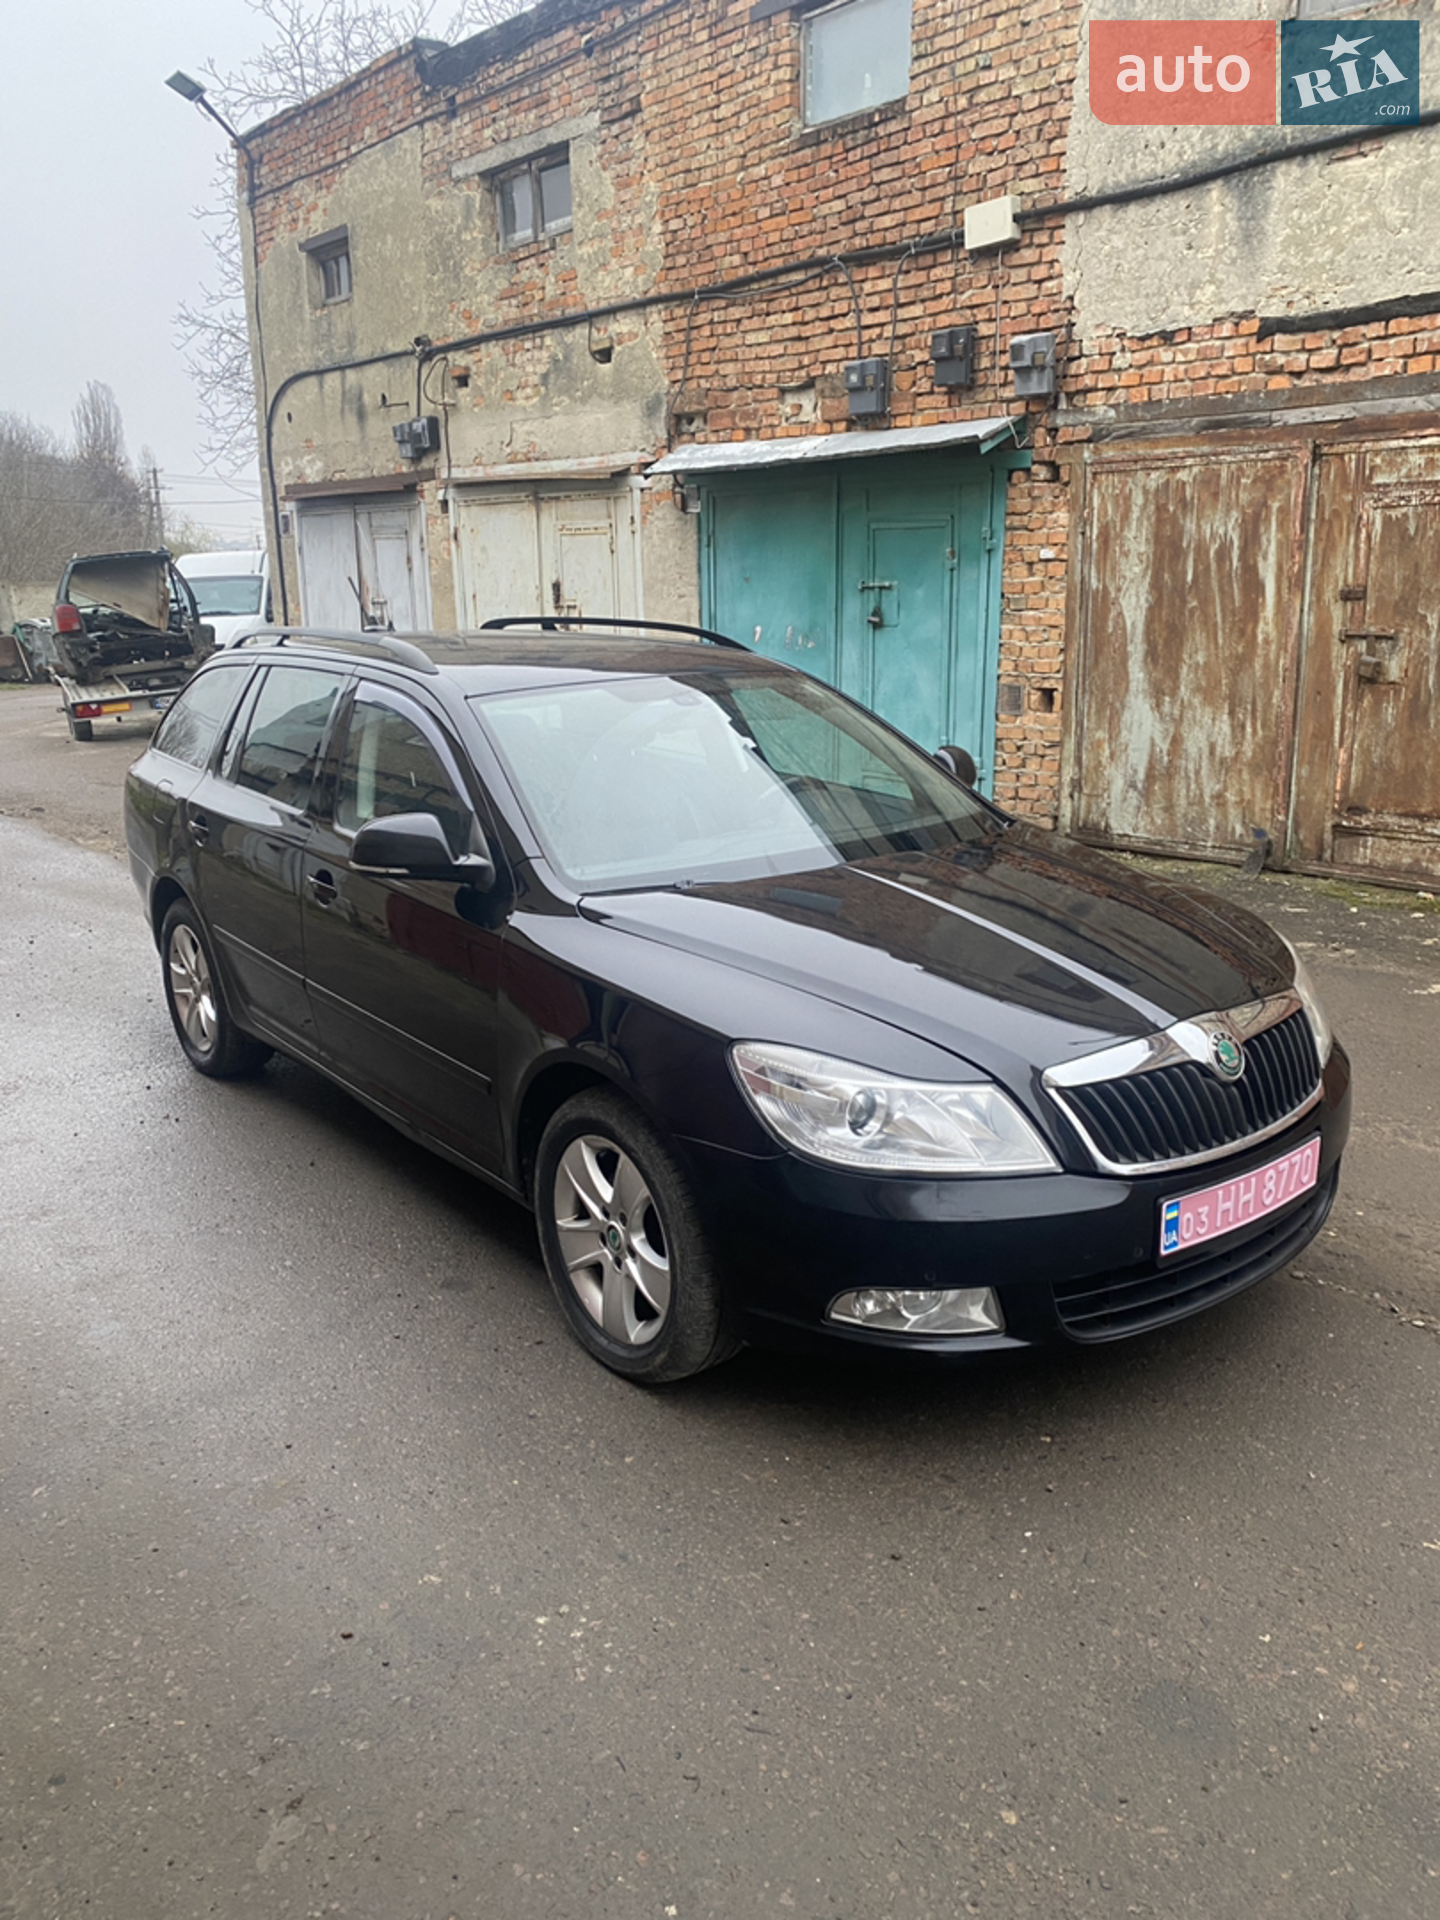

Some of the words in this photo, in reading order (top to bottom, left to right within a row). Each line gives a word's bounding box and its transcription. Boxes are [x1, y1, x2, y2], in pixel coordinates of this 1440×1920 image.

[1162, 1229, 1179, 1247] UA
[1181, 1204, 1210, 1241] 03
[1215, 1176, 1257, 1229] HH
[1261, 1147, 1314, 1207] 8770
